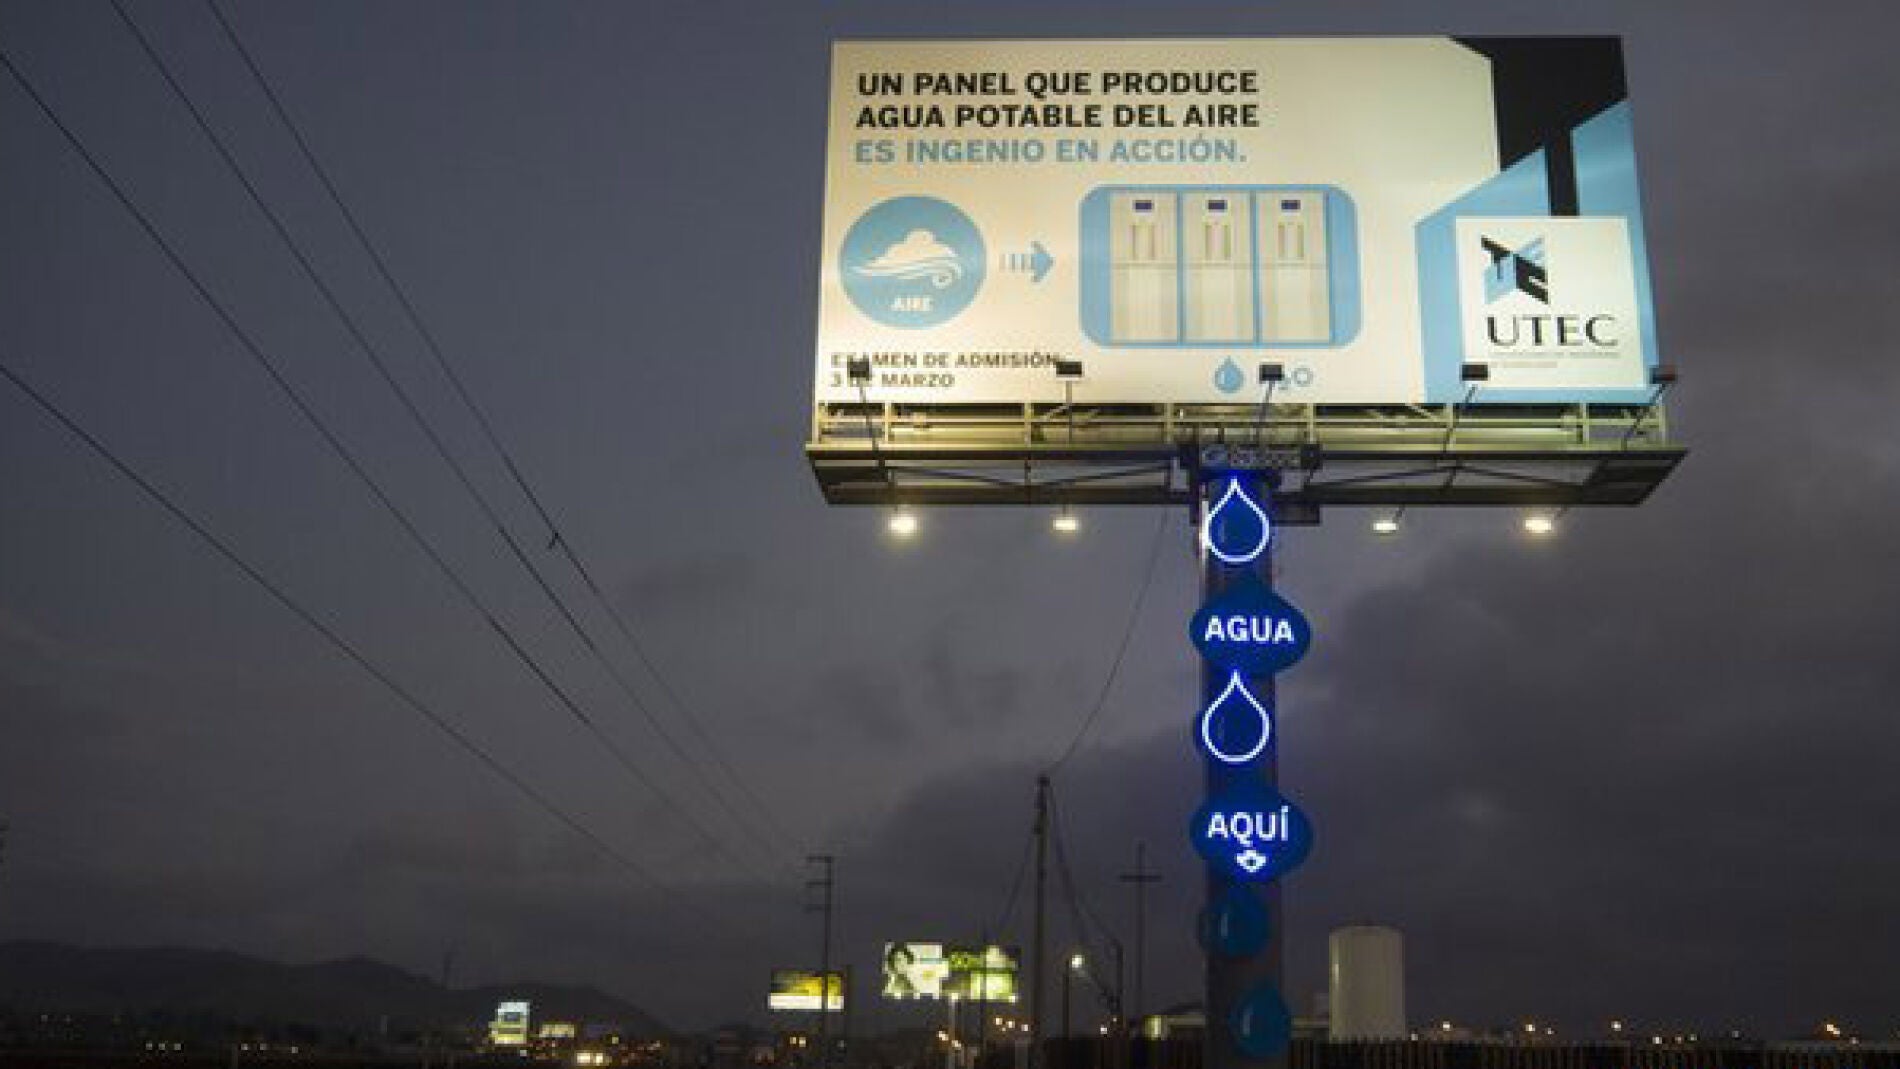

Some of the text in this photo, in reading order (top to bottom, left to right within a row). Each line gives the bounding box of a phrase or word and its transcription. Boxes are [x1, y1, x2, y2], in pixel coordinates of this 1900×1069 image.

[858, 71, 1259, 100] UN PANEL QUE PRODUCE
[856, 104, 1260, 128] AGUA POTABLE DEL AIRE
[855, 133, 1247, 162] ES INGENIO EN ACCIÓN.
[890, 296, 934, 312] AIRE
[1486, 314, 1618, 346] UTEC
[923, 351, 949, 368] DE
[831, 372, 842, 388] 3
[881, 373, 955, 388] MARZO
[1204, 615, 1294, 645] AGUA
[1207, 805, 1289, 847] AQUÍ
